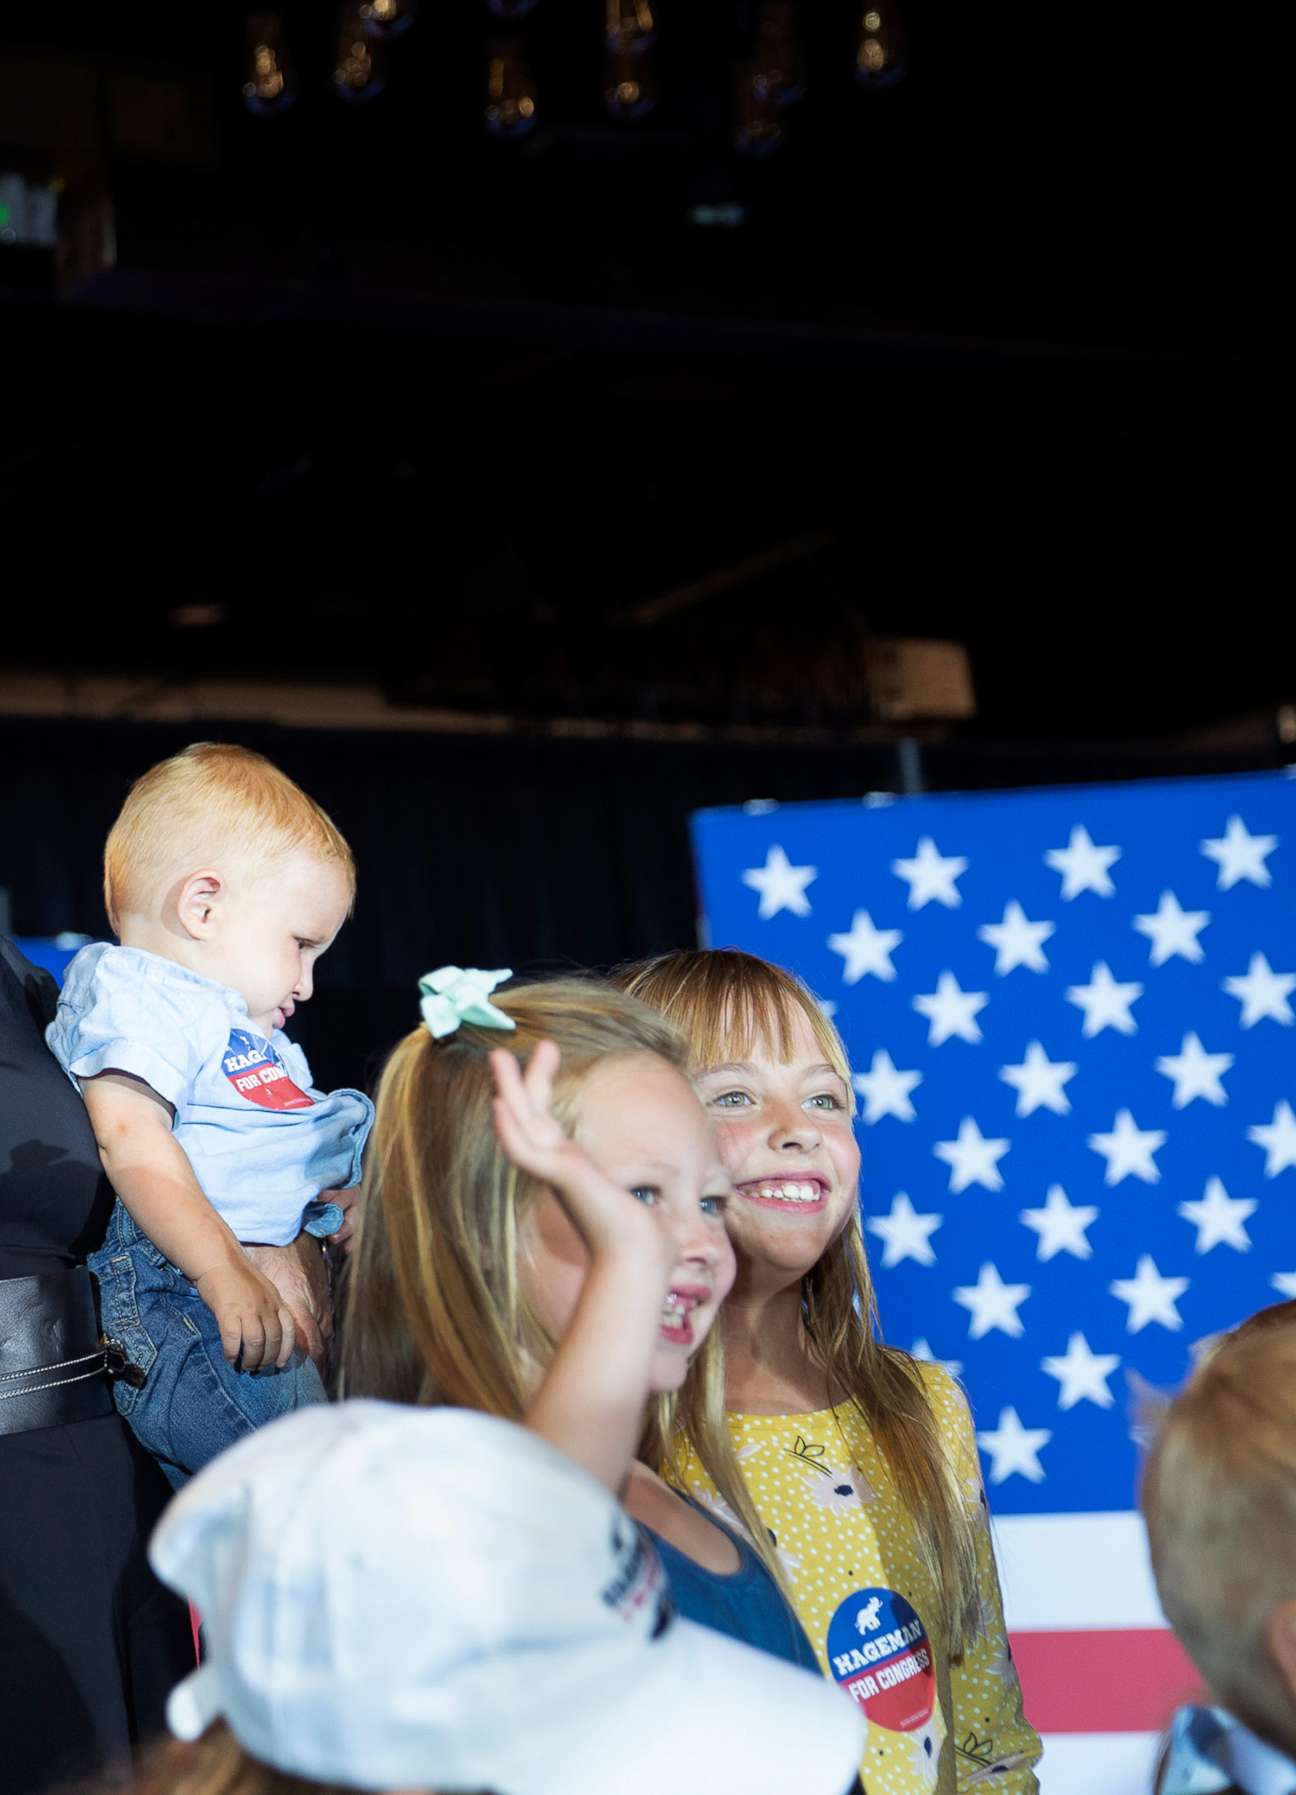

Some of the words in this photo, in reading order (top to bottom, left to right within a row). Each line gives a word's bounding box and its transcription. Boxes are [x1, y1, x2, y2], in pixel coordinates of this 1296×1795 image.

[235, 1074, 263, 1092] FOR
[832, 1620, 923, 1676] HAGEMAN
[848, 1675, 880, 1703] FOR
[875, 1648, 930, 1690] CONGRESS
